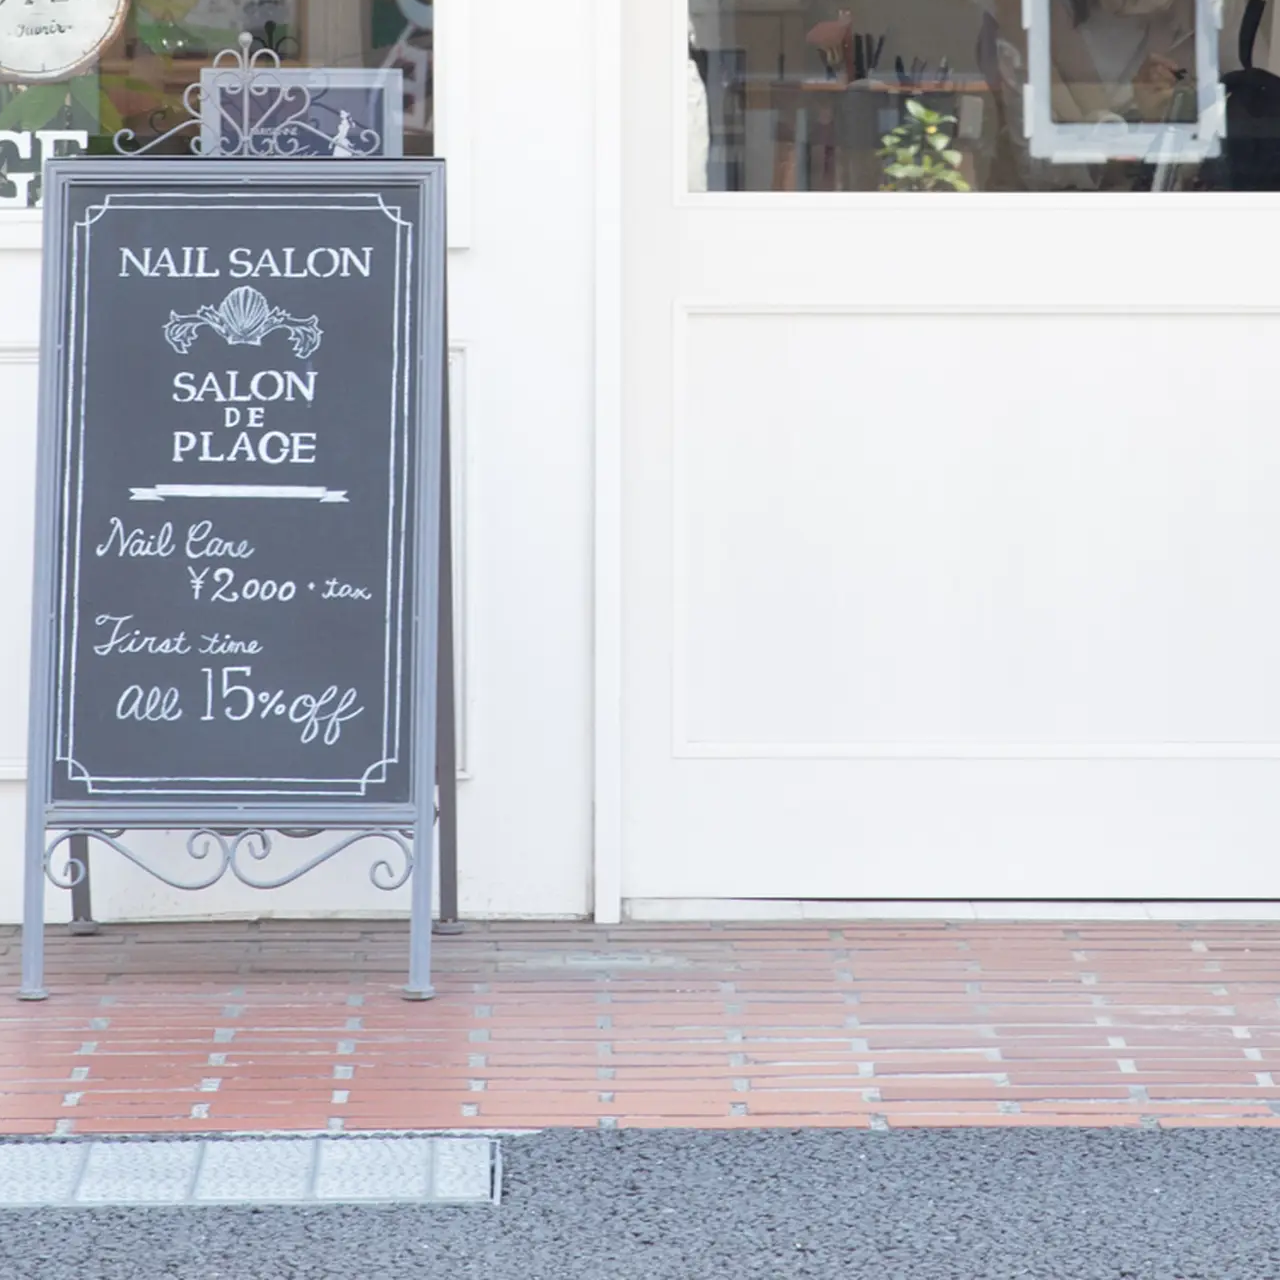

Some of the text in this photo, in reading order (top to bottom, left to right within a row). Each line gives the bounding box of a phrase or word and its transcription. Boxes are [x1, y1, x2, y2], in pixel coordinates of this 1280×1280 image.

[118, 246, 374, 279] NAIL SALON
[172, 370, 319, 403] SALON
[224, 407, 265, 429] DE
[171, 431, 317, 465] PLAGE
[95, 516, 255, 559] Nail Care
[187, 565, 373, 603] ¥2000 tax
[93, 614, 264, 656] First time
